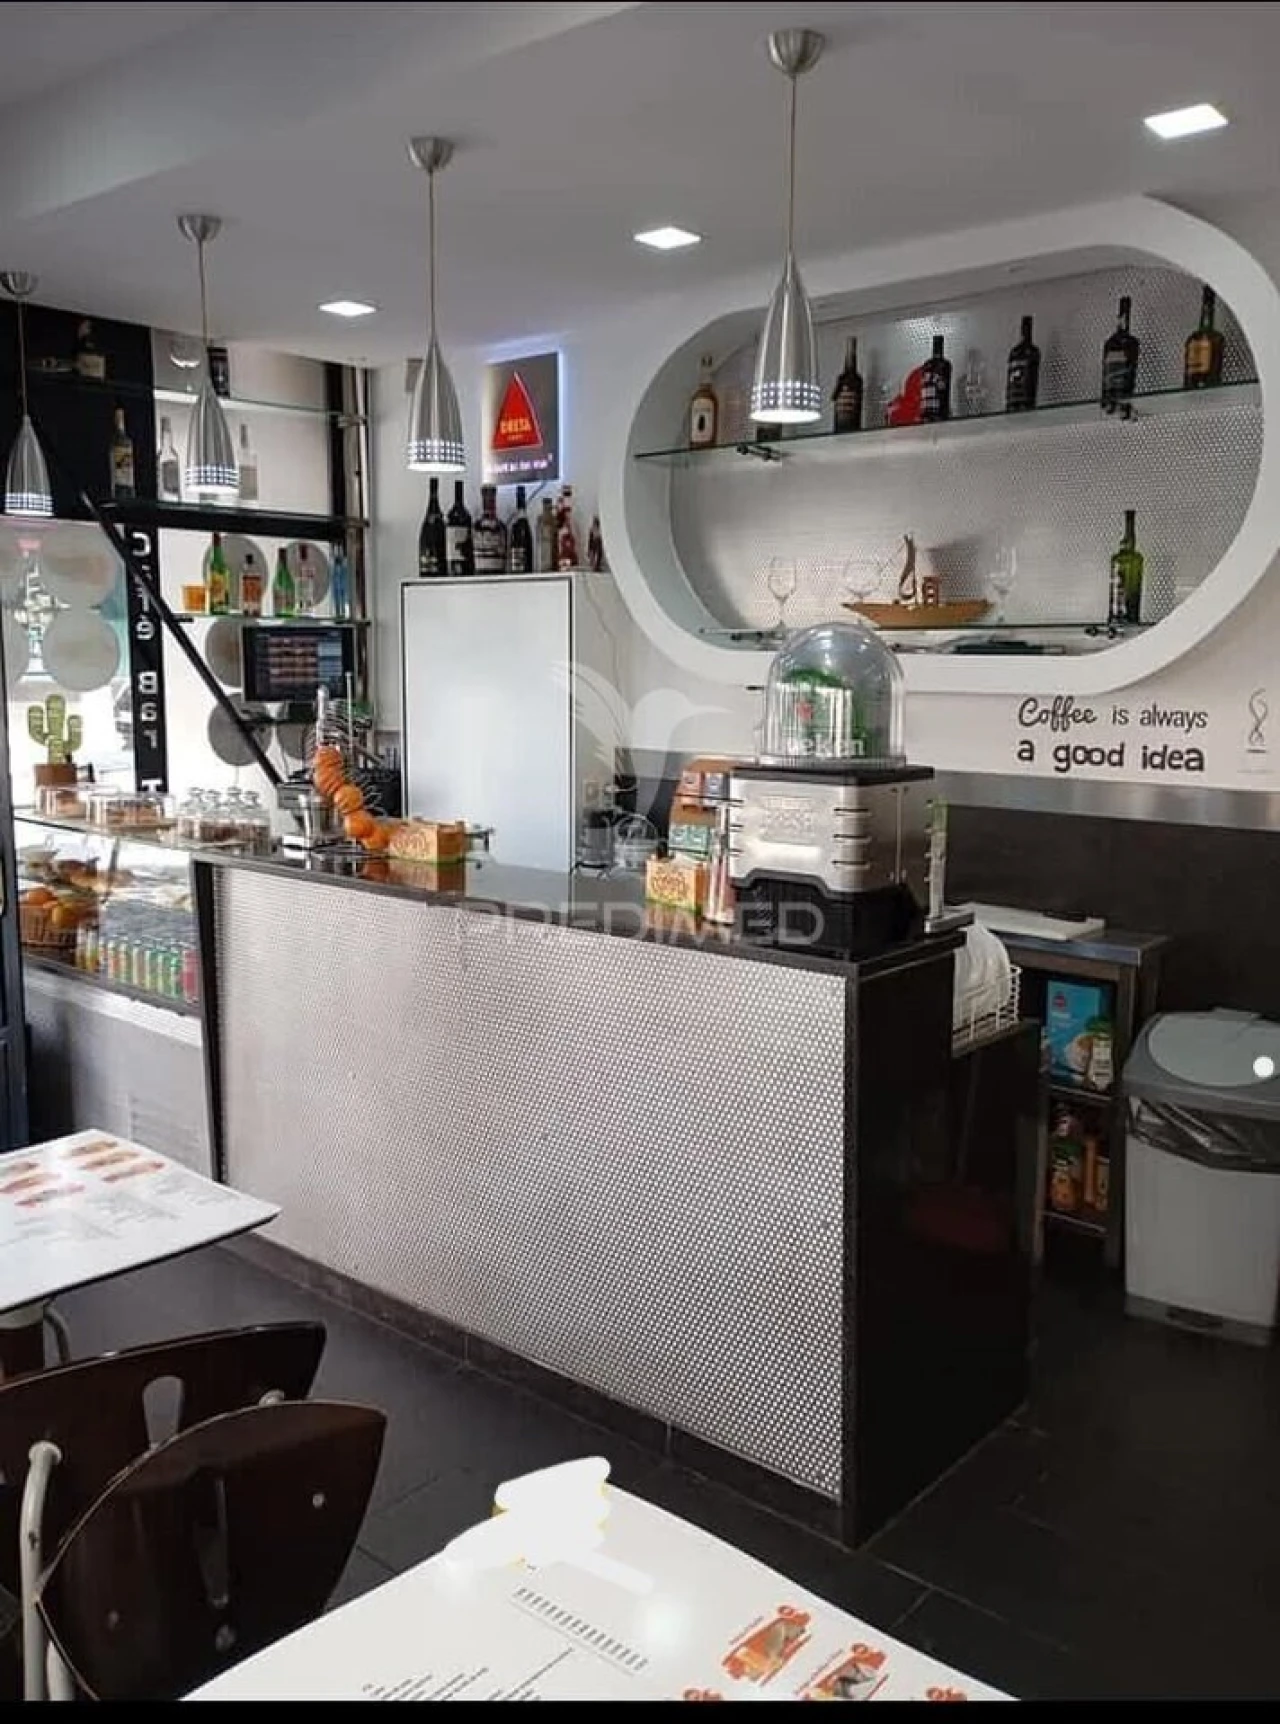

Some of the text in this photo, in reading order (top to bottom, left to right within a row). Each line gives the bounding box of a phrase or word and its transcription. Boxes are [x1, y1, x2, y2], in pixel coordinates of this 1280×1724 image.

[1018, 695, 1209, 733] Coffee is always
[1017, 739, 1206, 773] a good idea
